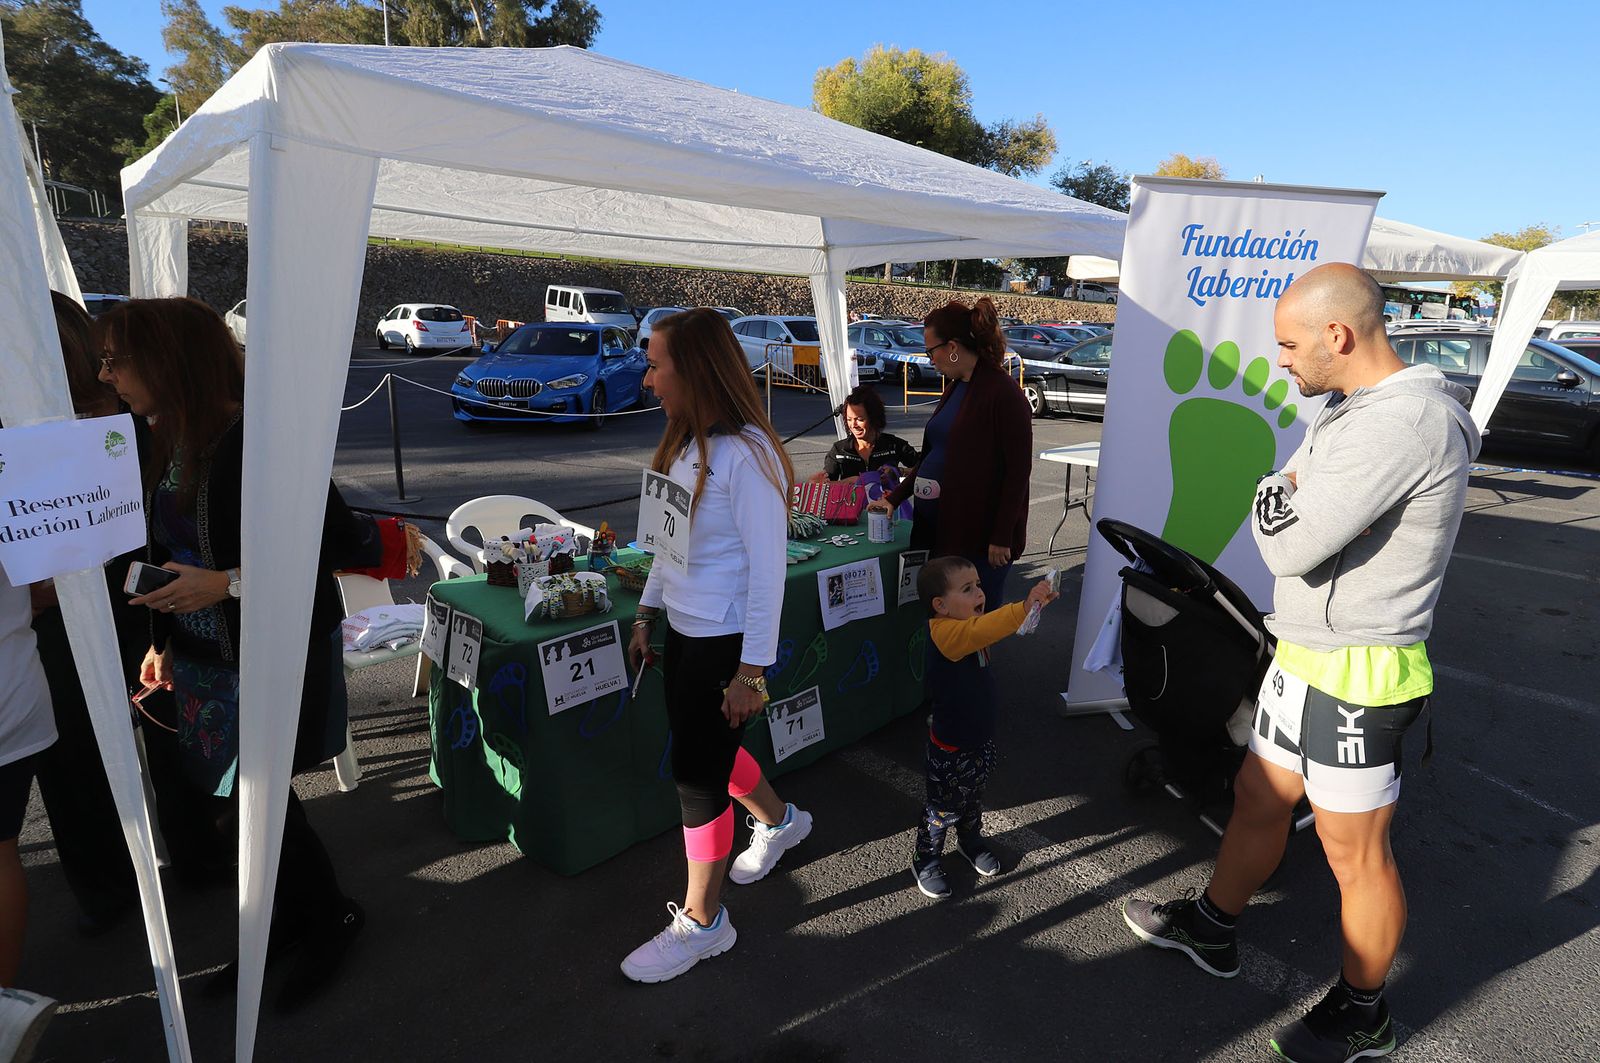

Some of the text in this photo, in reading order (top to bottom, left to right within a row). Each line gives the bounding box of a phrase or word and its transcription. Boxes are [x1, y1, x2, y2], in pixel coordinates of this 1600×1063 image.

[1181, 224, 1319, 261] Fundación
[1186, 266, 1294, 307] Laberint
[1540, 386, 1587, 394] STEPWAY
[7, 485, 111, 518] Reservado
[86, 500, 140, 527] Laberinto
[663, 510, 675, 538] 70
[462, 643, 473, 664] 72
[569, 658, 595, 683] 21
[1272, 669, 1284, 698] 49
[595, 680, 618, 692] HUELVA
[785, 716, 804, 736] 71
